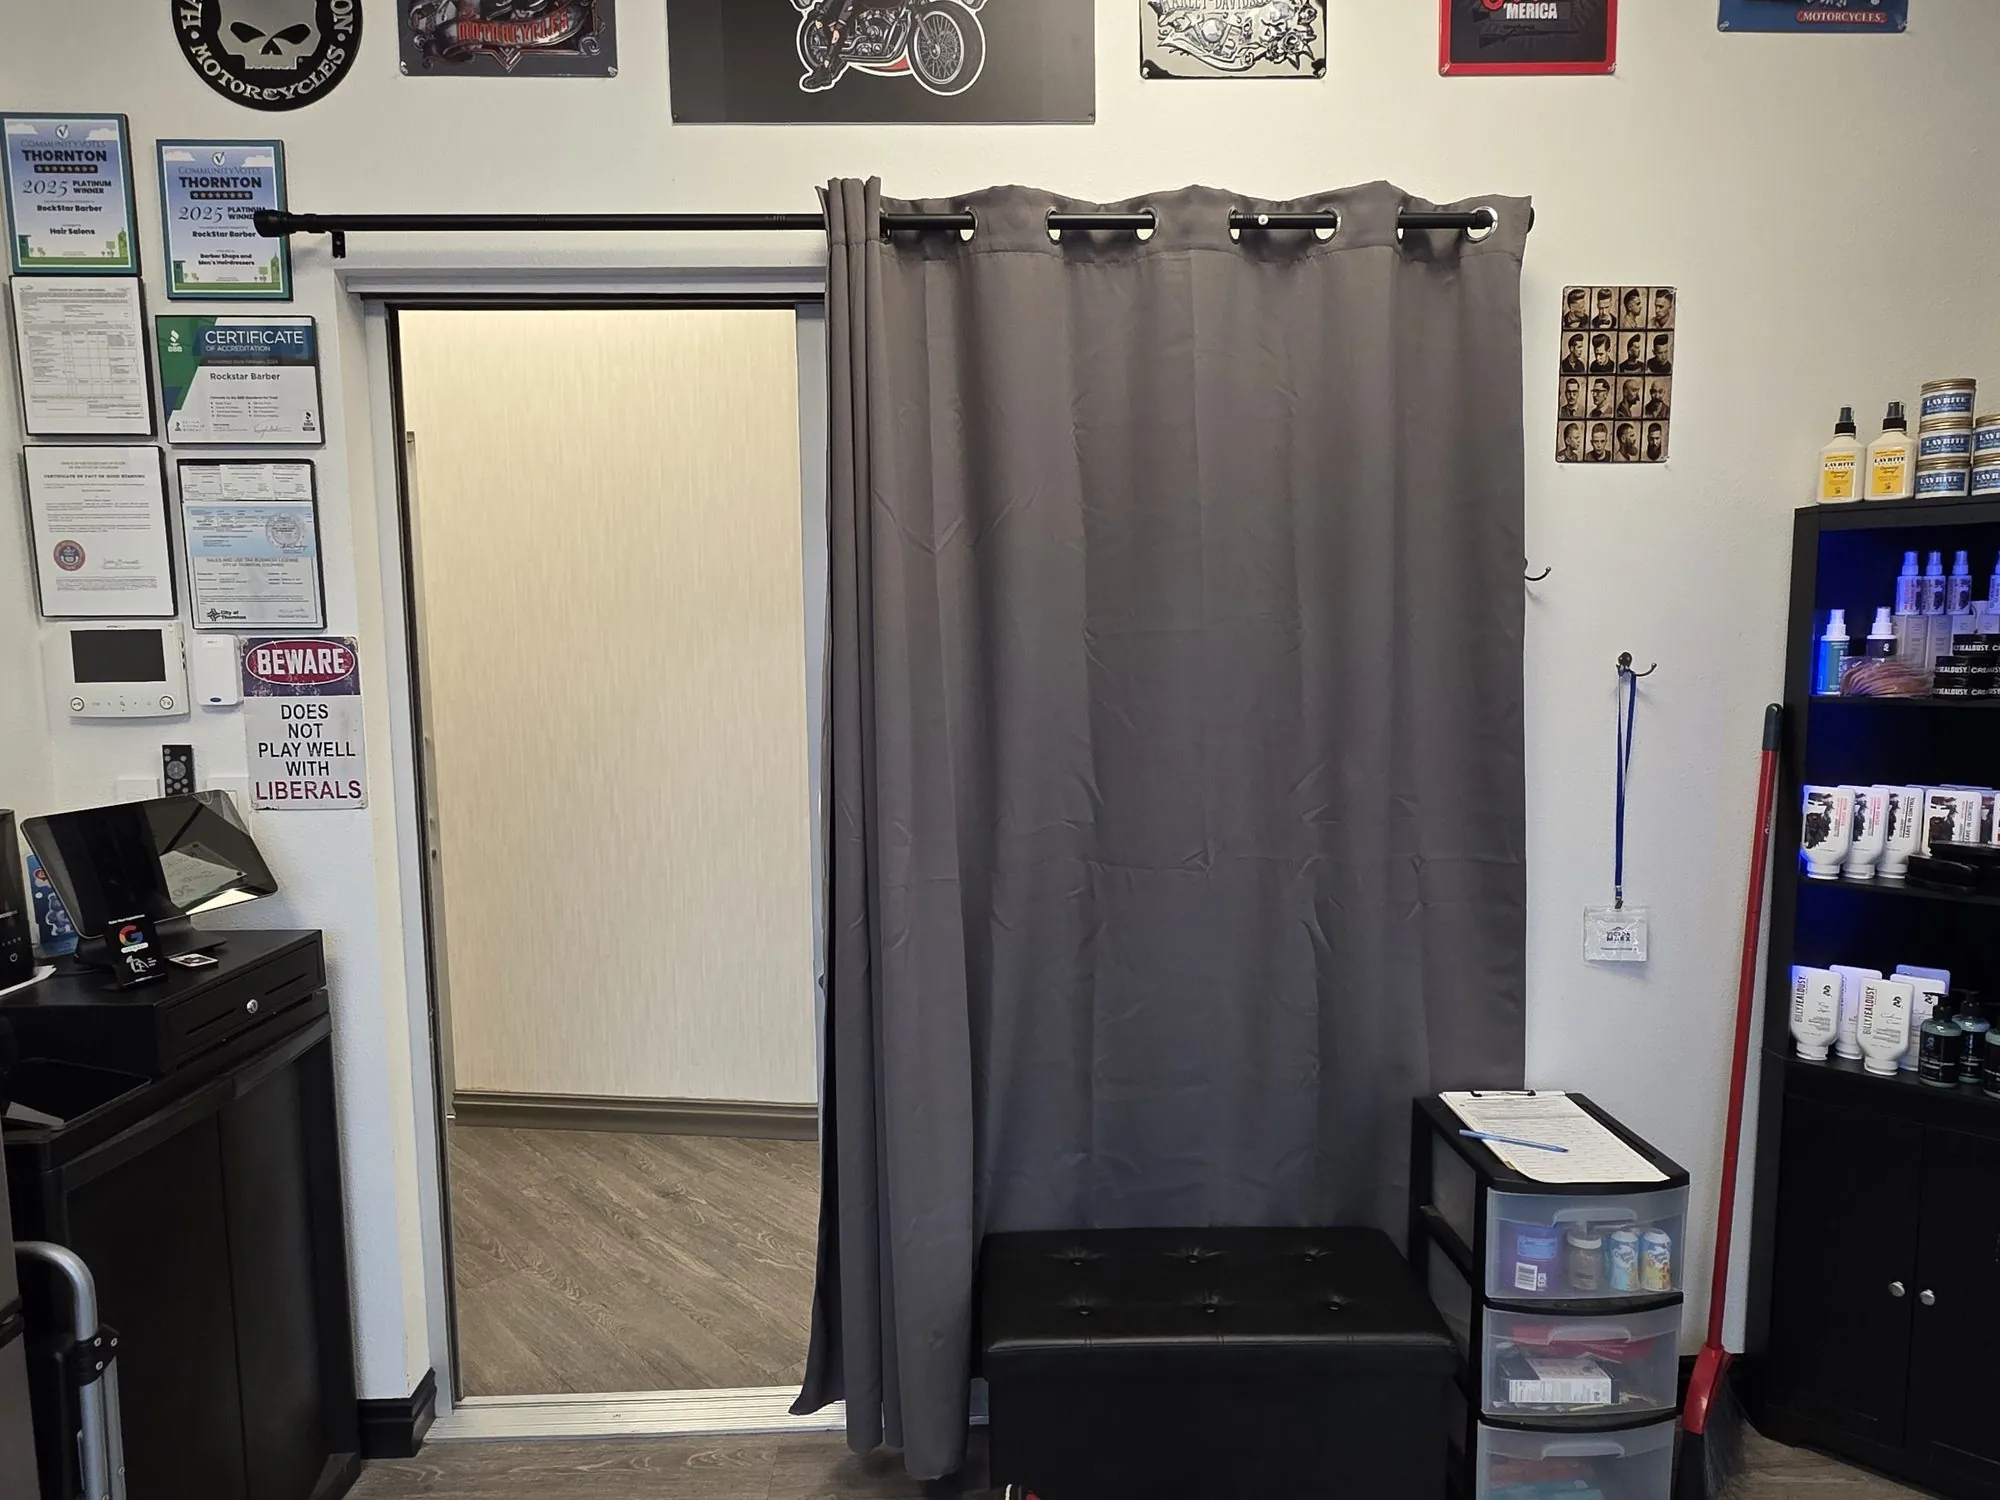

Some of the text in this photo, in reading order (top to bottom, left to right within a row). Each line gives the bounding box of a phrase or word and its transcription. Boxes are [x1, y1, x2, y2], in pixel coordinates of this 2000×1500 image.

[1803, 11, 1882, 22] MOTORCYCLES
[458, 11, 569, 44] MOTORCYCLES
[190, 43, 346, 100] MOTORCYCLES
[22, 149, 107, 162] THORNTON
[22, 180, 68, 198] 2025
[179, 176, 262, 188] THORNTON
[178, 206, 223, 223] 2025
[192, 230, 257, 238] RockStar Barber
[205, 330, 304, 344] CERTIFICATE
[210, 372, 281, 381] Rockstar Barber
[256, 649, 346, 675] BEWARE
[281, 704, 329, 720] DOES
[288, 723, 324, 738] NOT
[258, 741, 356, 758] PLAY WELL
[285, 760, 330, 776] WITH
[255, 780, 362, 800] LIBERALS
[1793, 975, 1807, 1023] BILLYJEALOUSY
[1862, 985, 1875, 1035] BILLYJEALOUSY
